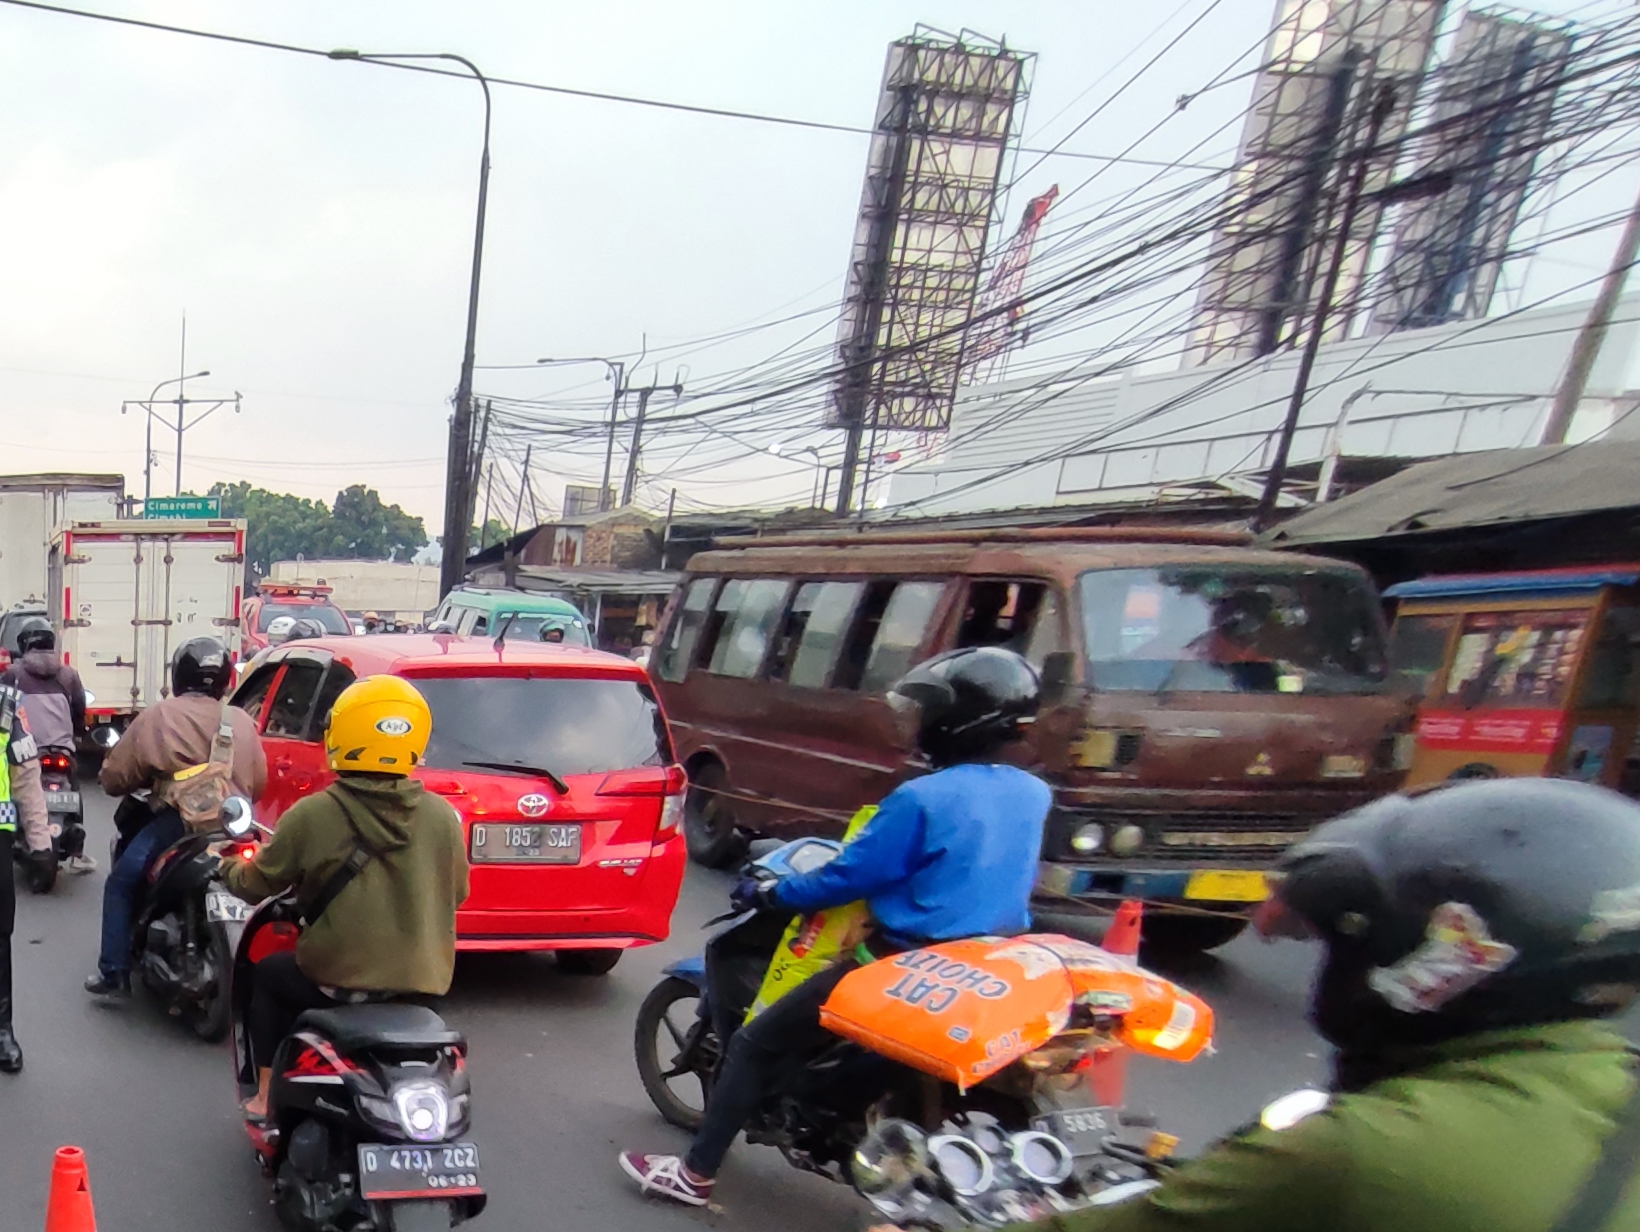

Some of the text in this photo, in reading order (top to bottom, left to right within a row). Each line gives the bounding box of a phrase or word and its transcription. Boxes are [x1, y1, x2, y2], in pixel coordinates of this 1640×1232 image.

[476, 827, 486, 847] D
[885, 973, 958, 1013] CAT
[366, 1151, 378, 1172] D
[443, 1148, 476, 1168] ZCZ
